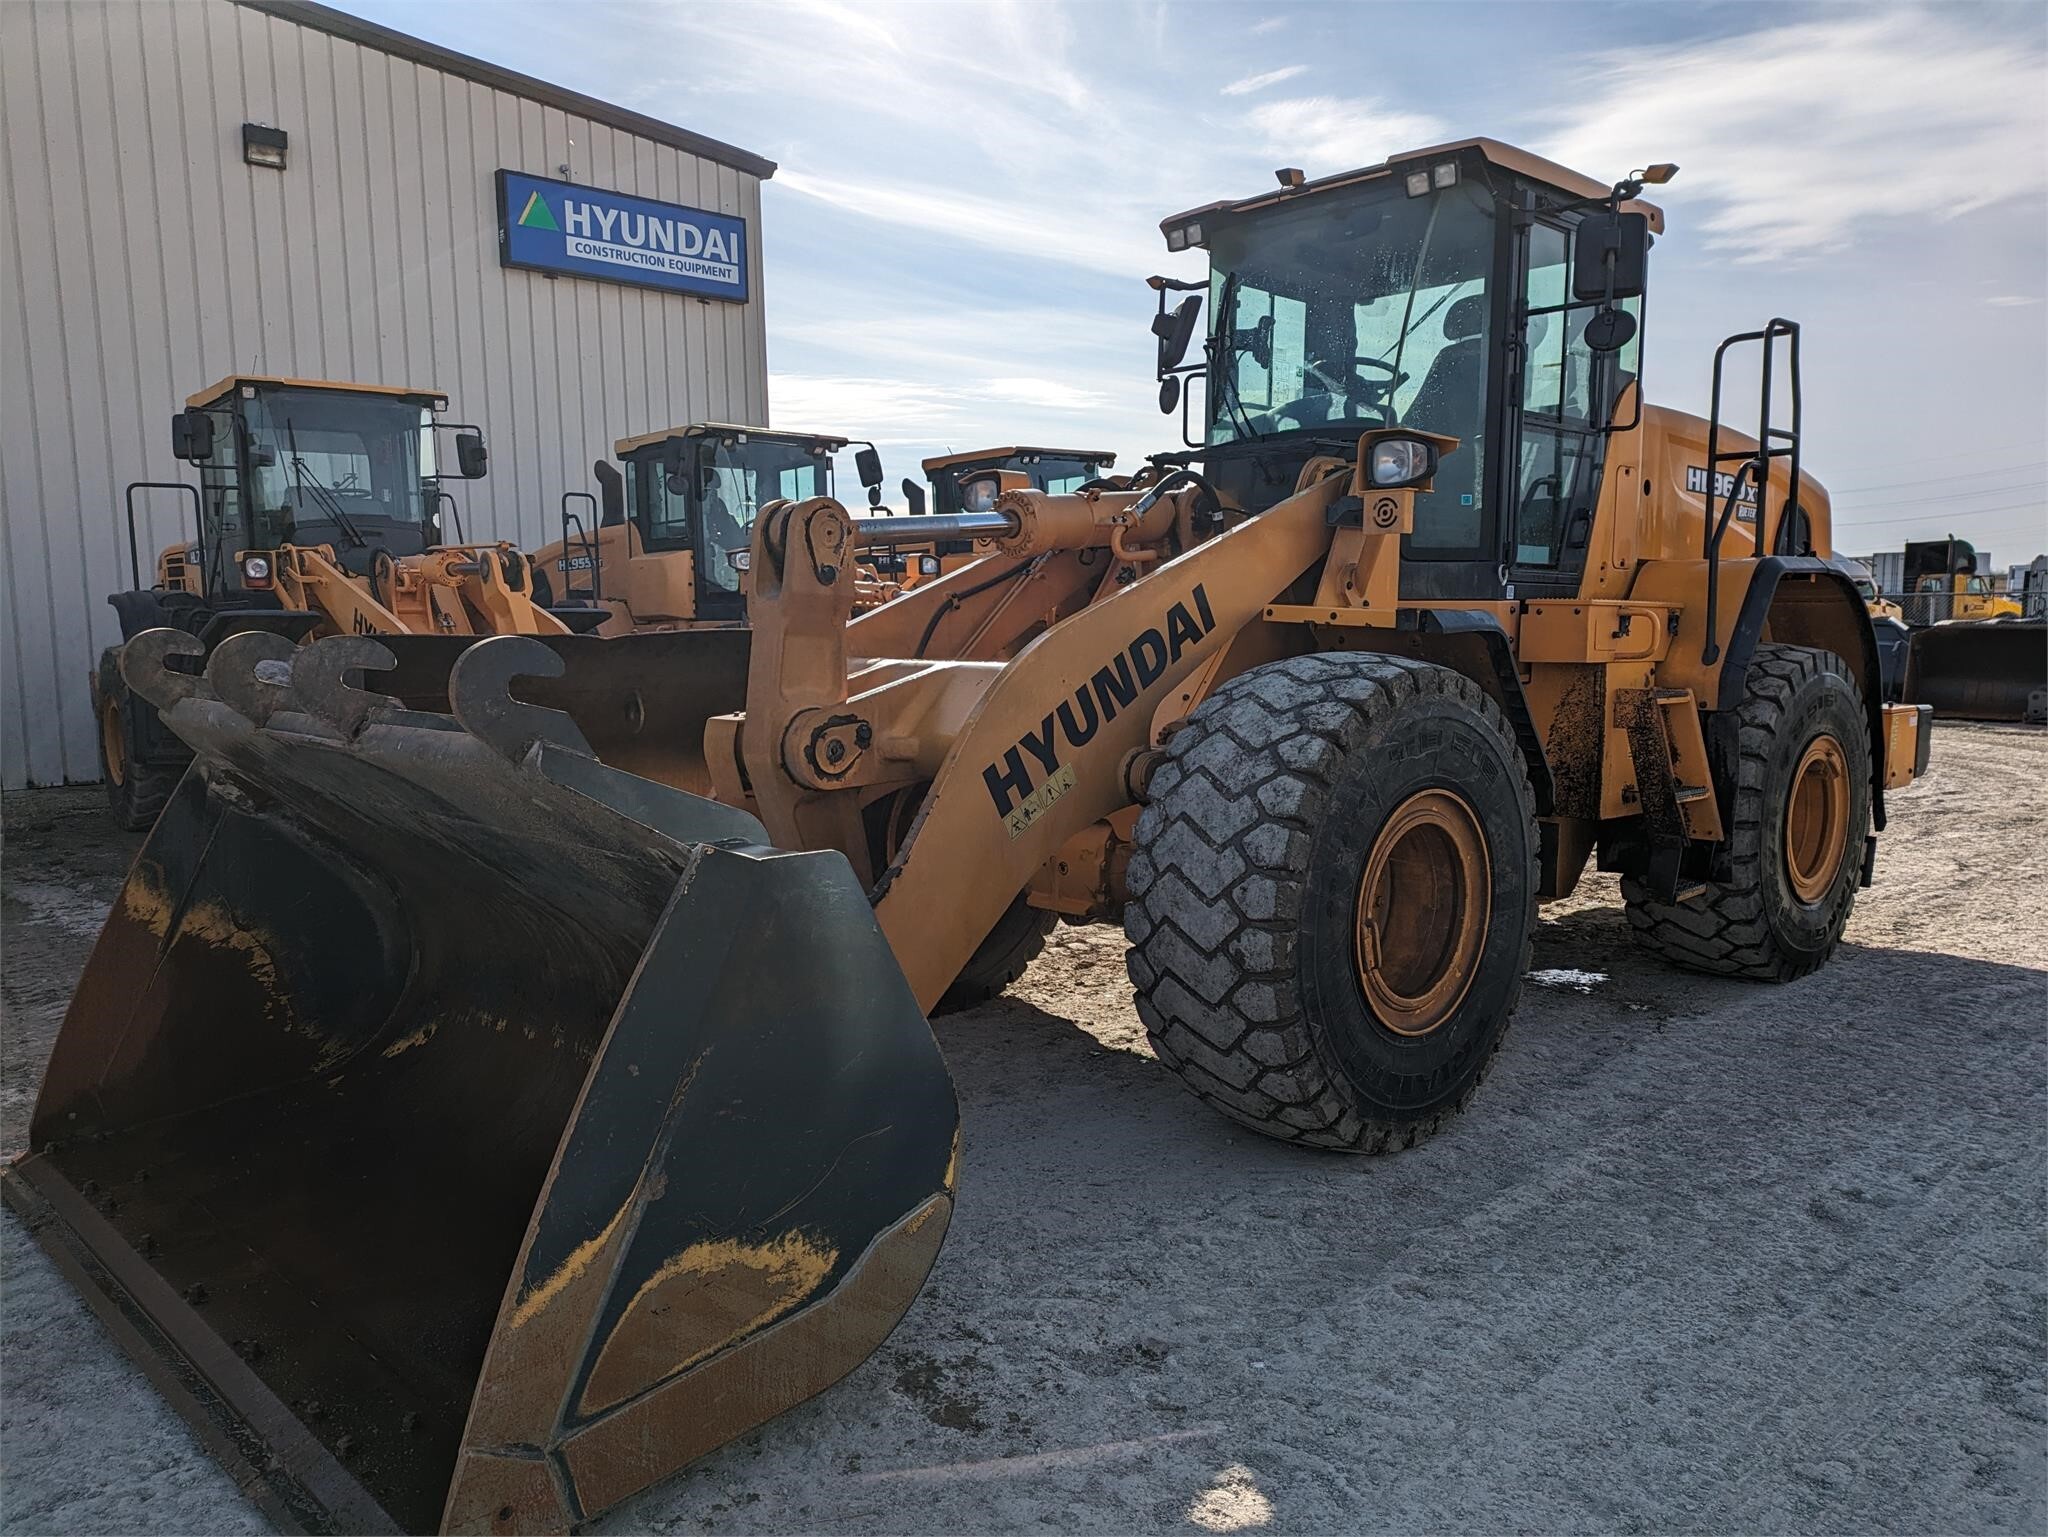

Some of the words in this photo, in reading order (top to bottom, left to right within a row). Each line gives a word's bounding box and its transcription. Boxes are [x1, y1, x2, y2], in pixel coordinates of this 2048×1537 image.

[564, 199, 739, 264] HYUNDAI
[575, 242, 665, 268] CONSTRUCTION
[668, 259, 732, 279] EQUIPMENT
[982, 582, 1217, 819] HYUNDAI
